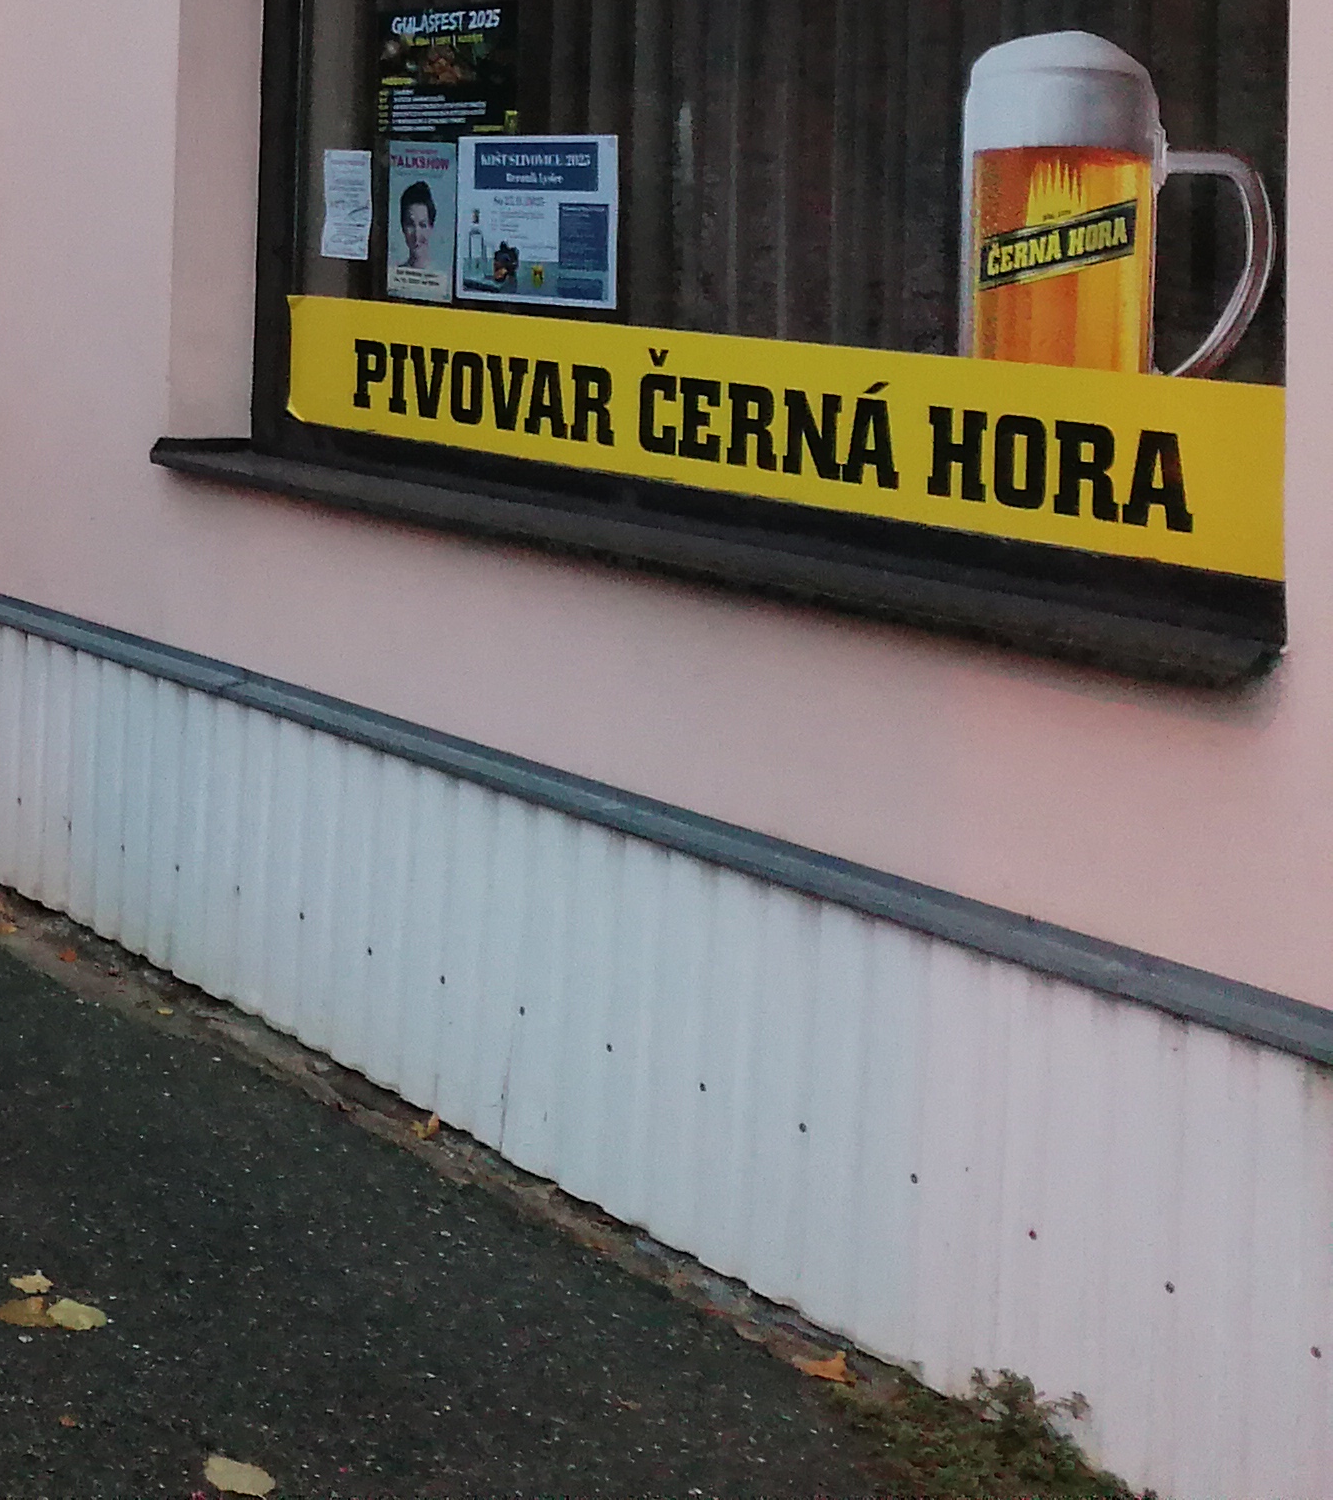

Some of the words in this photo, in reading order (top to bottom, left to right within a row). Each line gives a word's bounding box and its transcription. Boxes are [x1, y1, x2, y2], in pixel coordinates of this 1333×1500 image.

[468, 8, 501, 30] 2025
[986, 229, 1062, 276] ČERNÁ
[1068, 216, 1128, 257] HORA
[351, 338, 616, 450] PIVOVAR
[637, 349, 900, 491] ČERNÁ
[927, 405, 1194, 534] HORA
